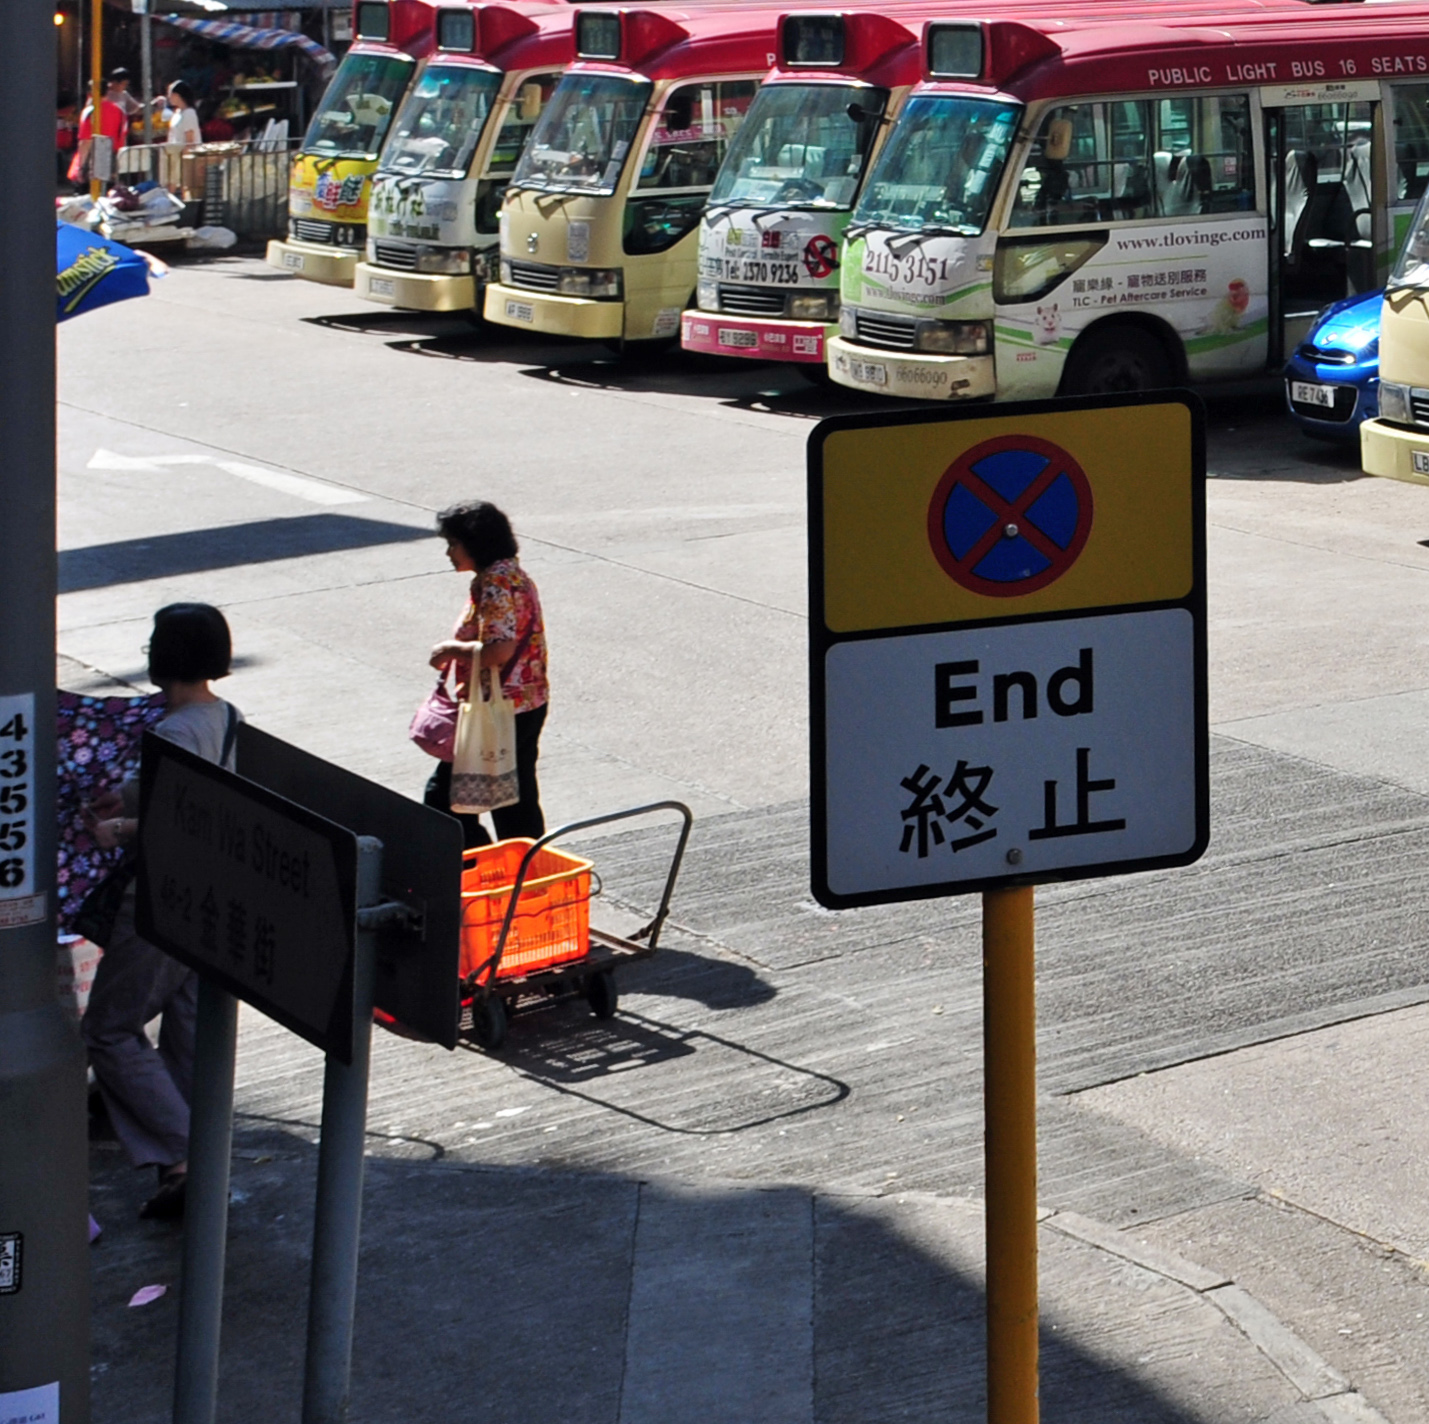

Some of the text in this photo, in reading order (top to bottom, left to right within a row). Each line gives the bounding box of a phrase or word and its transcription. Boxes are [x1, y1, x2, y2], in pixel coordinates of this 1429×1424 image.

[1148, 67, 1212, 85] PUBLIC
[1226, 63, 1278, 81] LIGHT
[1291, 60, 1325, 76] BUS
[1339, 59, 1357, 75] 16
[1372, 56, 1427, 73] SEATS
[1116, 228, 1266, 251] www.tlovingc.com
[866, 251, 948, 286] 2115 3151
[1073, 286, 1208, 307] TLC Pet Aftercare Service
[934, 649, 1096, 730] End
[896, 747, 1126, 860] 終止
[252, 824, 310, 899] Street
